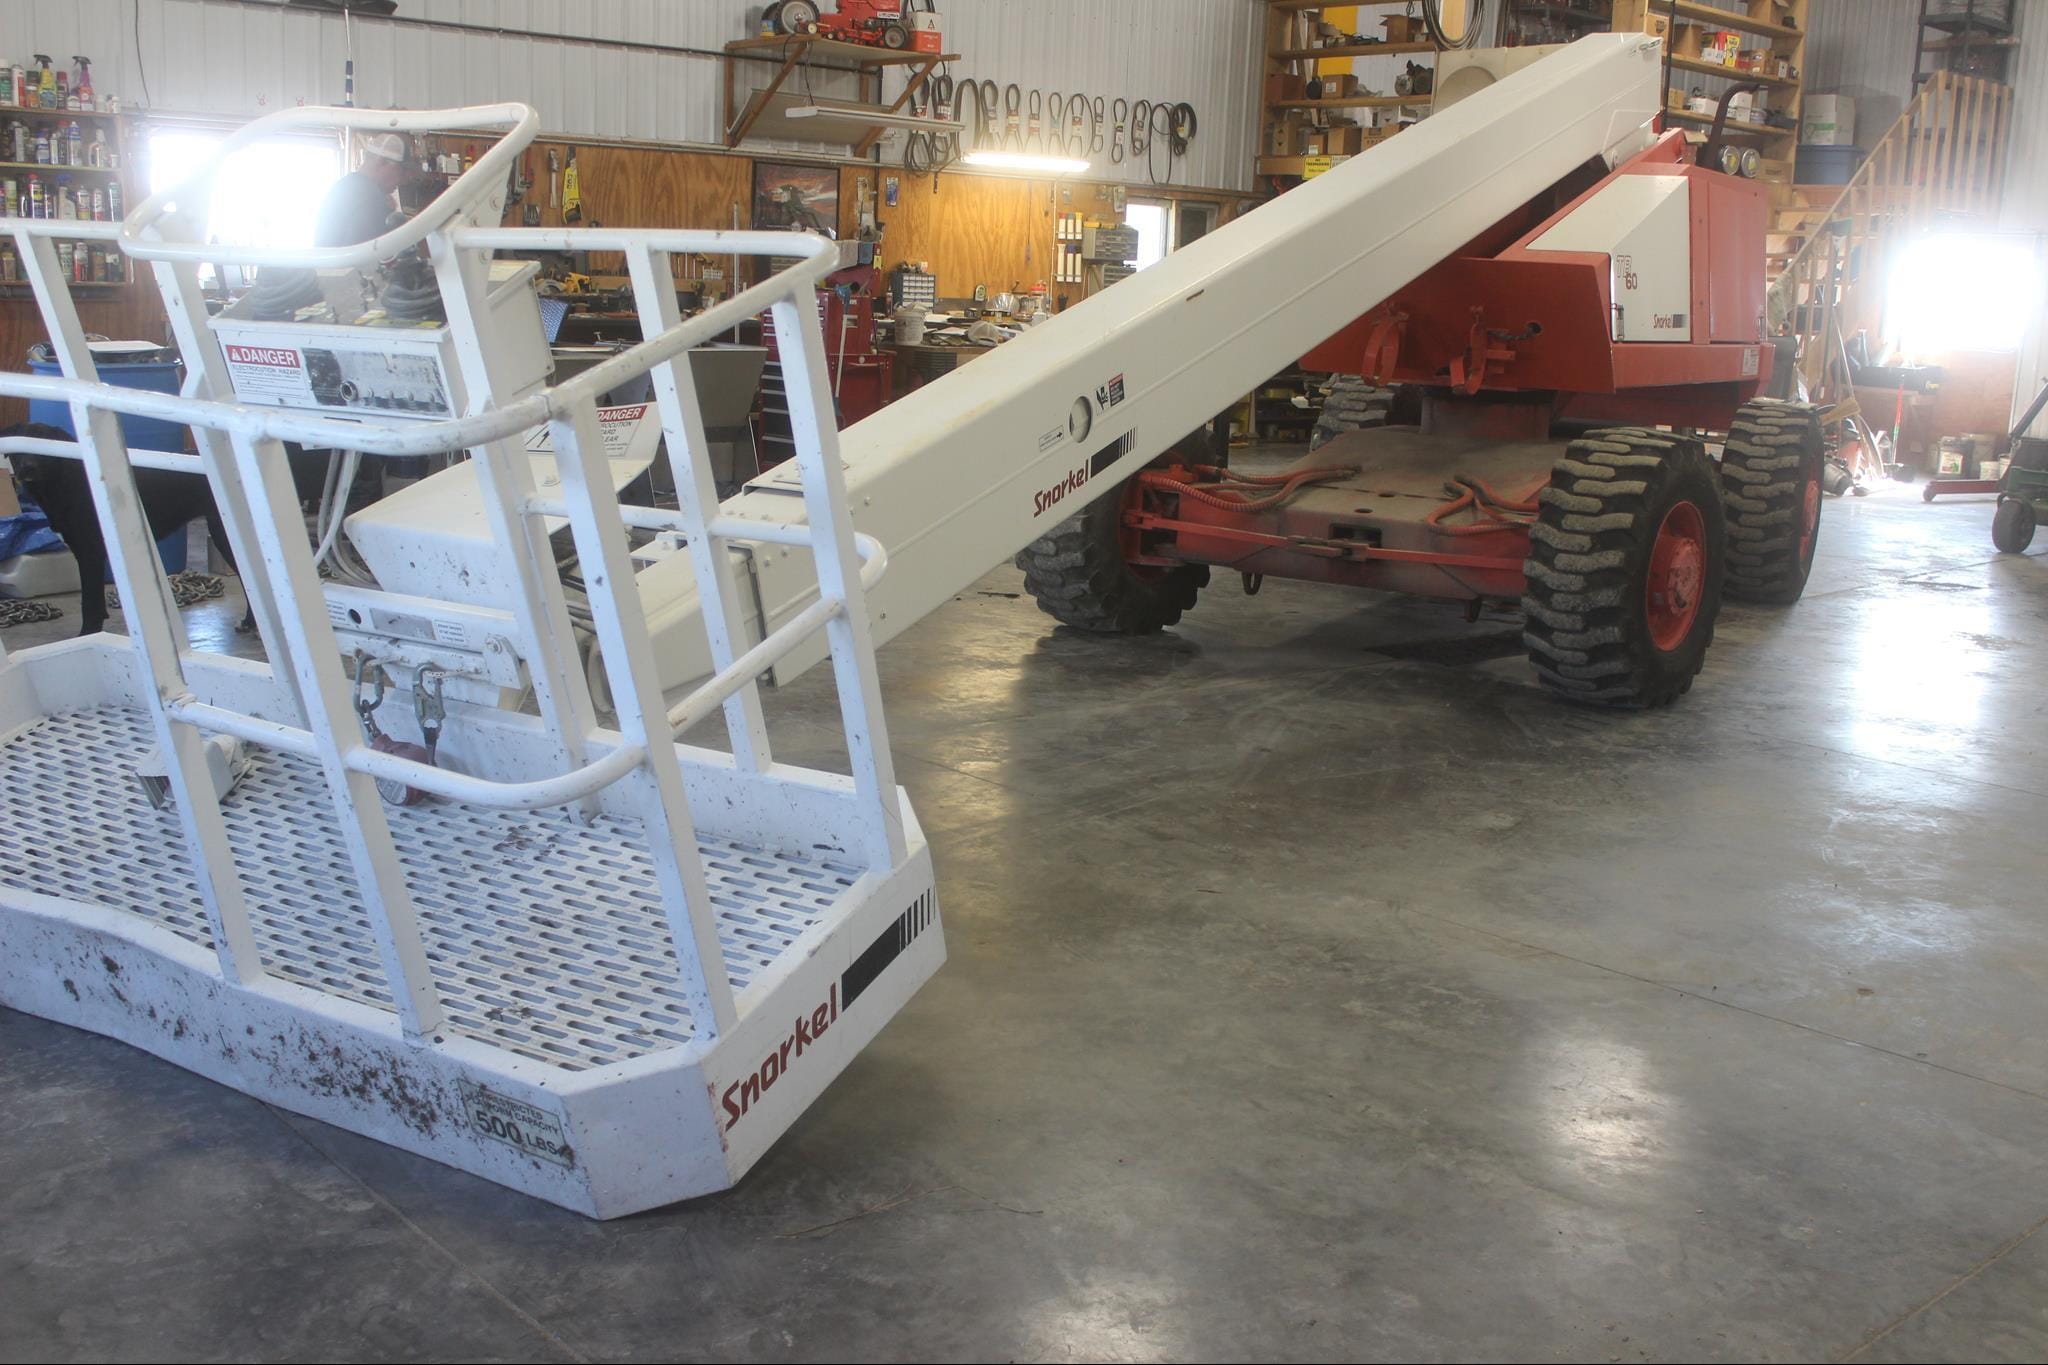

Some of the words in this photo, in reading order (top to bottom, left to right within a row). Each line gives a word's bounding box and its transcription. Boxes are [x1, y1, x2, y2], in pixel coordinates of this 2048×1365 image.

[1625, 272, 1638, 290] 60
[240, 348, 296, 366] DANGER
[1034, 459, 1089, 518] Snorkel
[722, 982, 837, 1132] Snorkel
[475, 1110, 523, 1145] 500
[526, 1132, 558, 1156] LBS
[515, 1112, 559, 1135] CAPACITY
